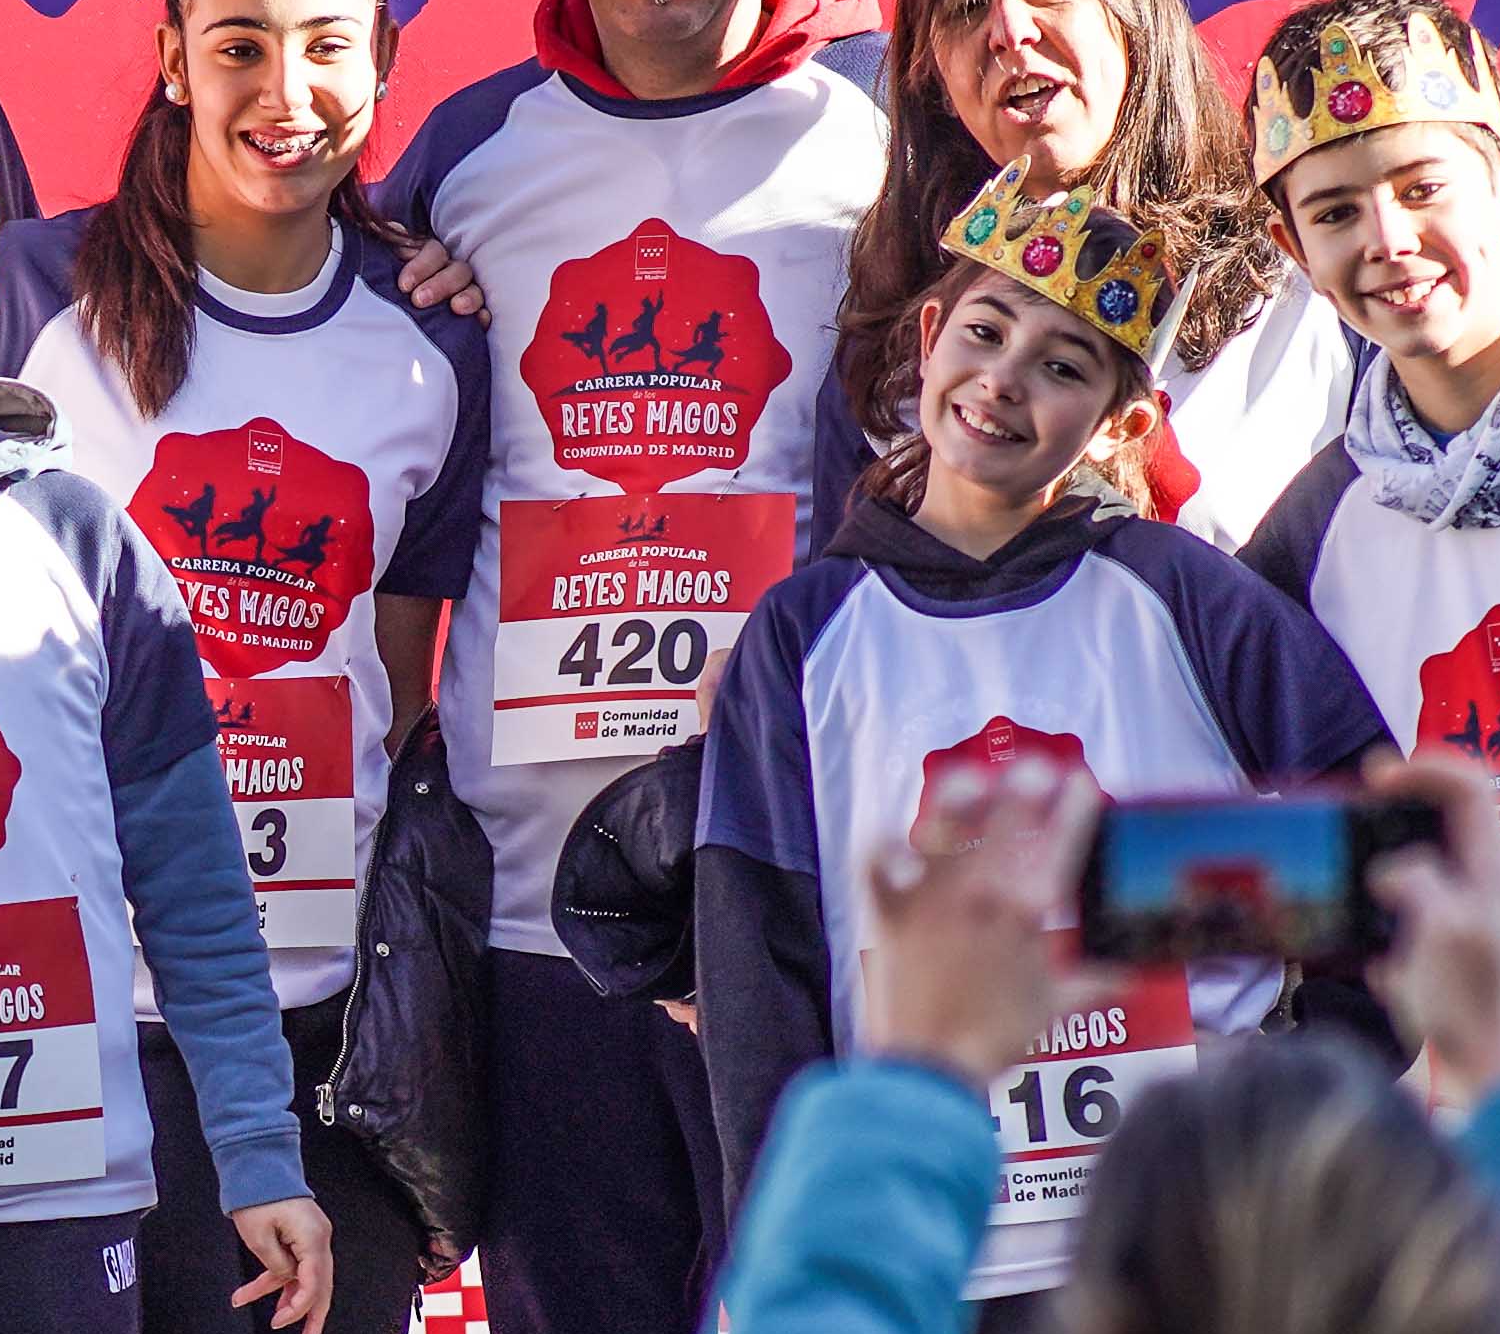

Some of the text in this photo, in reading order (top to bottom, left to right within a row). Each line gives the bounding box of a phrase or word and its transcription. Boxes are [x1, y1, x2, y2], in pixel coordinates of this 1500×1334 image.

[575, 375, 722, 392] CARRERA POPULAR
[561, 401, 739, 437] REYES MAGOS
[563, 444, 735, 459] COMUNIDAD DE MADRID
[580, 546, 707, 565] CARRERA POPULAR
[171, 557, 316, 592] CARRERA POPULAR
[552, 570, 730, 611] REYES MAGOS
[175, 578, 325, 629] YES MAGOS
[242, 633, 259, 646] DE
[261, 634, 313, 651] MADRID
[558, 618, 708, 687] 420
[602, 709, 679, 721] Comunidad
[601, 723, 677, 738] de Madrid
[228, 734, 287, 748] POPULAR
[226, 757, 304, 795] MAGOS
[1014, 1190, 1036, 1202] de
